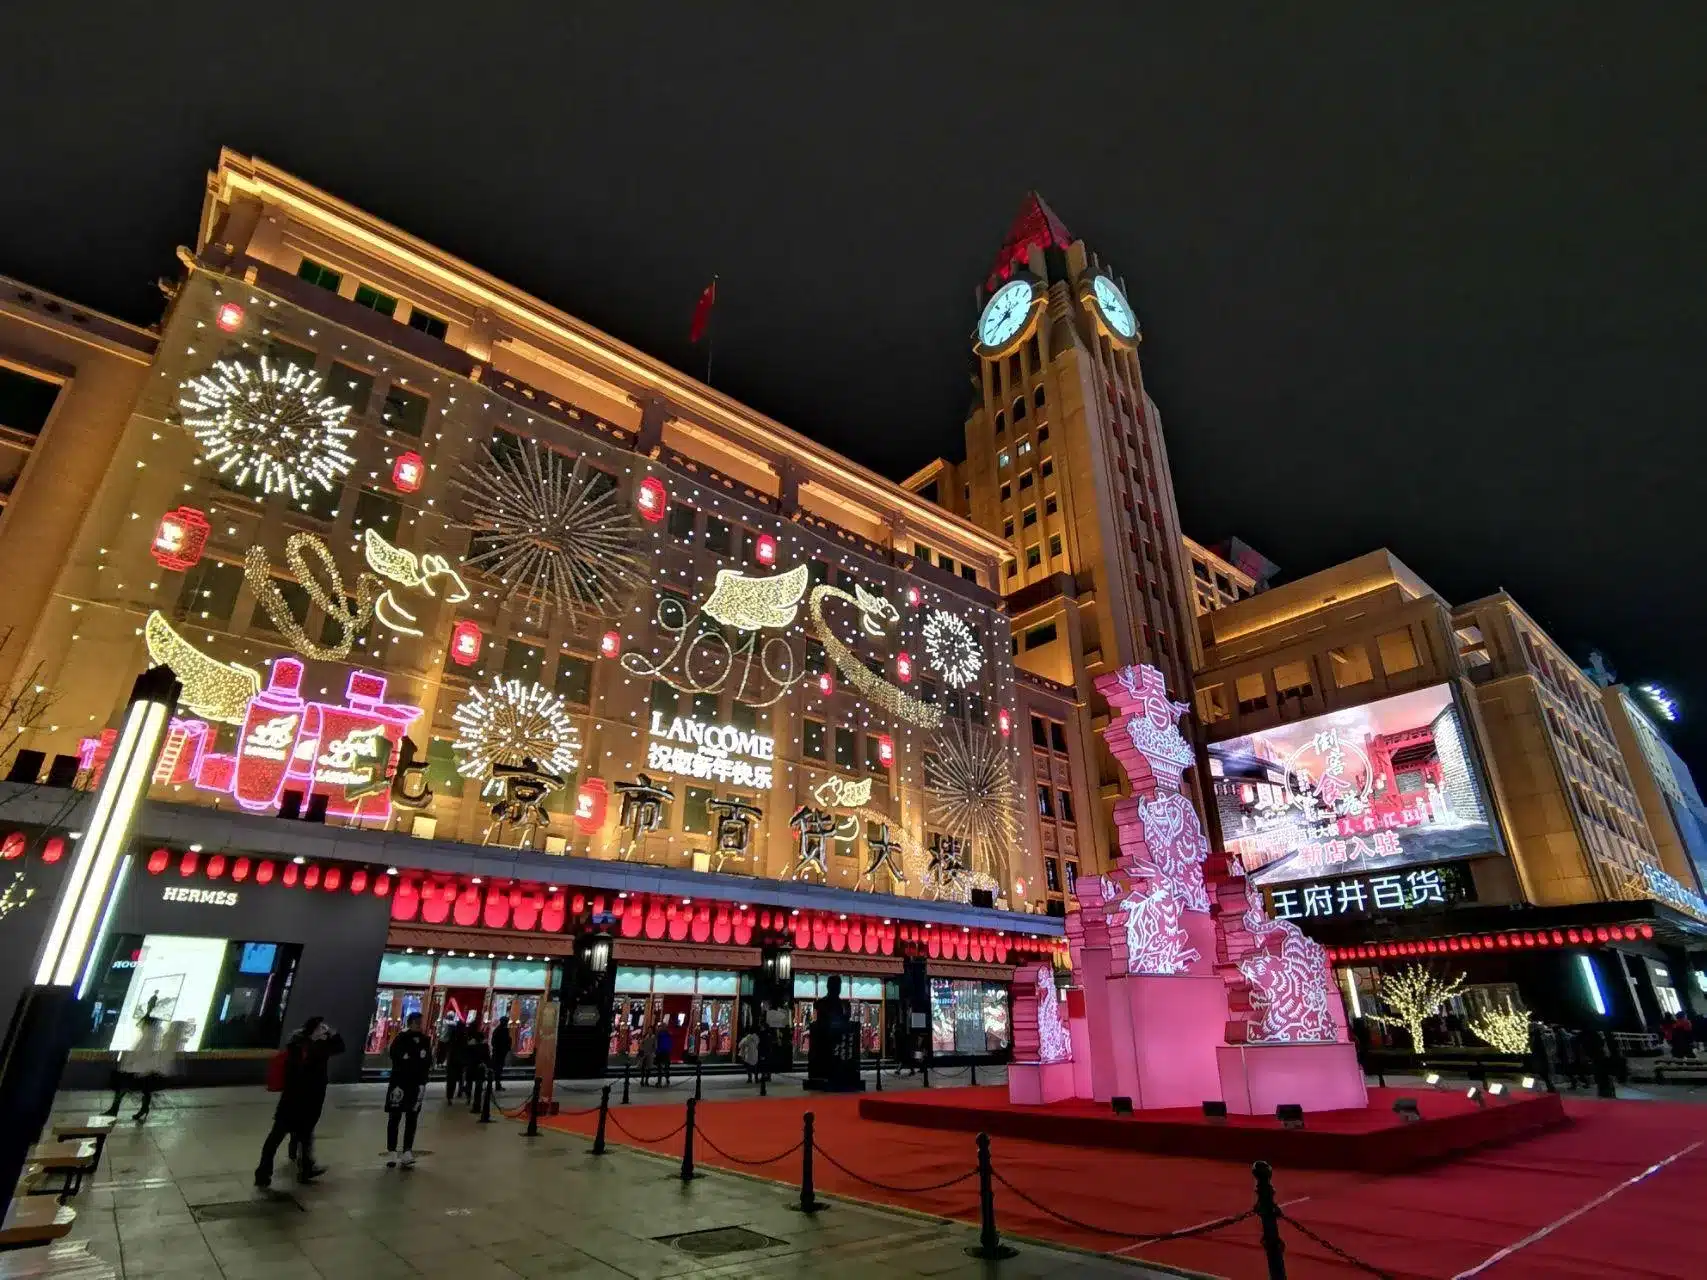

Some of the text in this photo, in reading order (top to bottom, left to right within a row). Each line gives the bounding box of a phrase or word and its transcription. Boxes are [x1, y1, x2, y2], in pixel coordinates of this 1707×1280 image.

[620, 598, 807, 708] 2019
[344, 735, 965, 884] 北京市百货大楼
[1301, 829, 1403, 867] 新店入驻
[1271, 869, 1445, 920] 王府井百货
